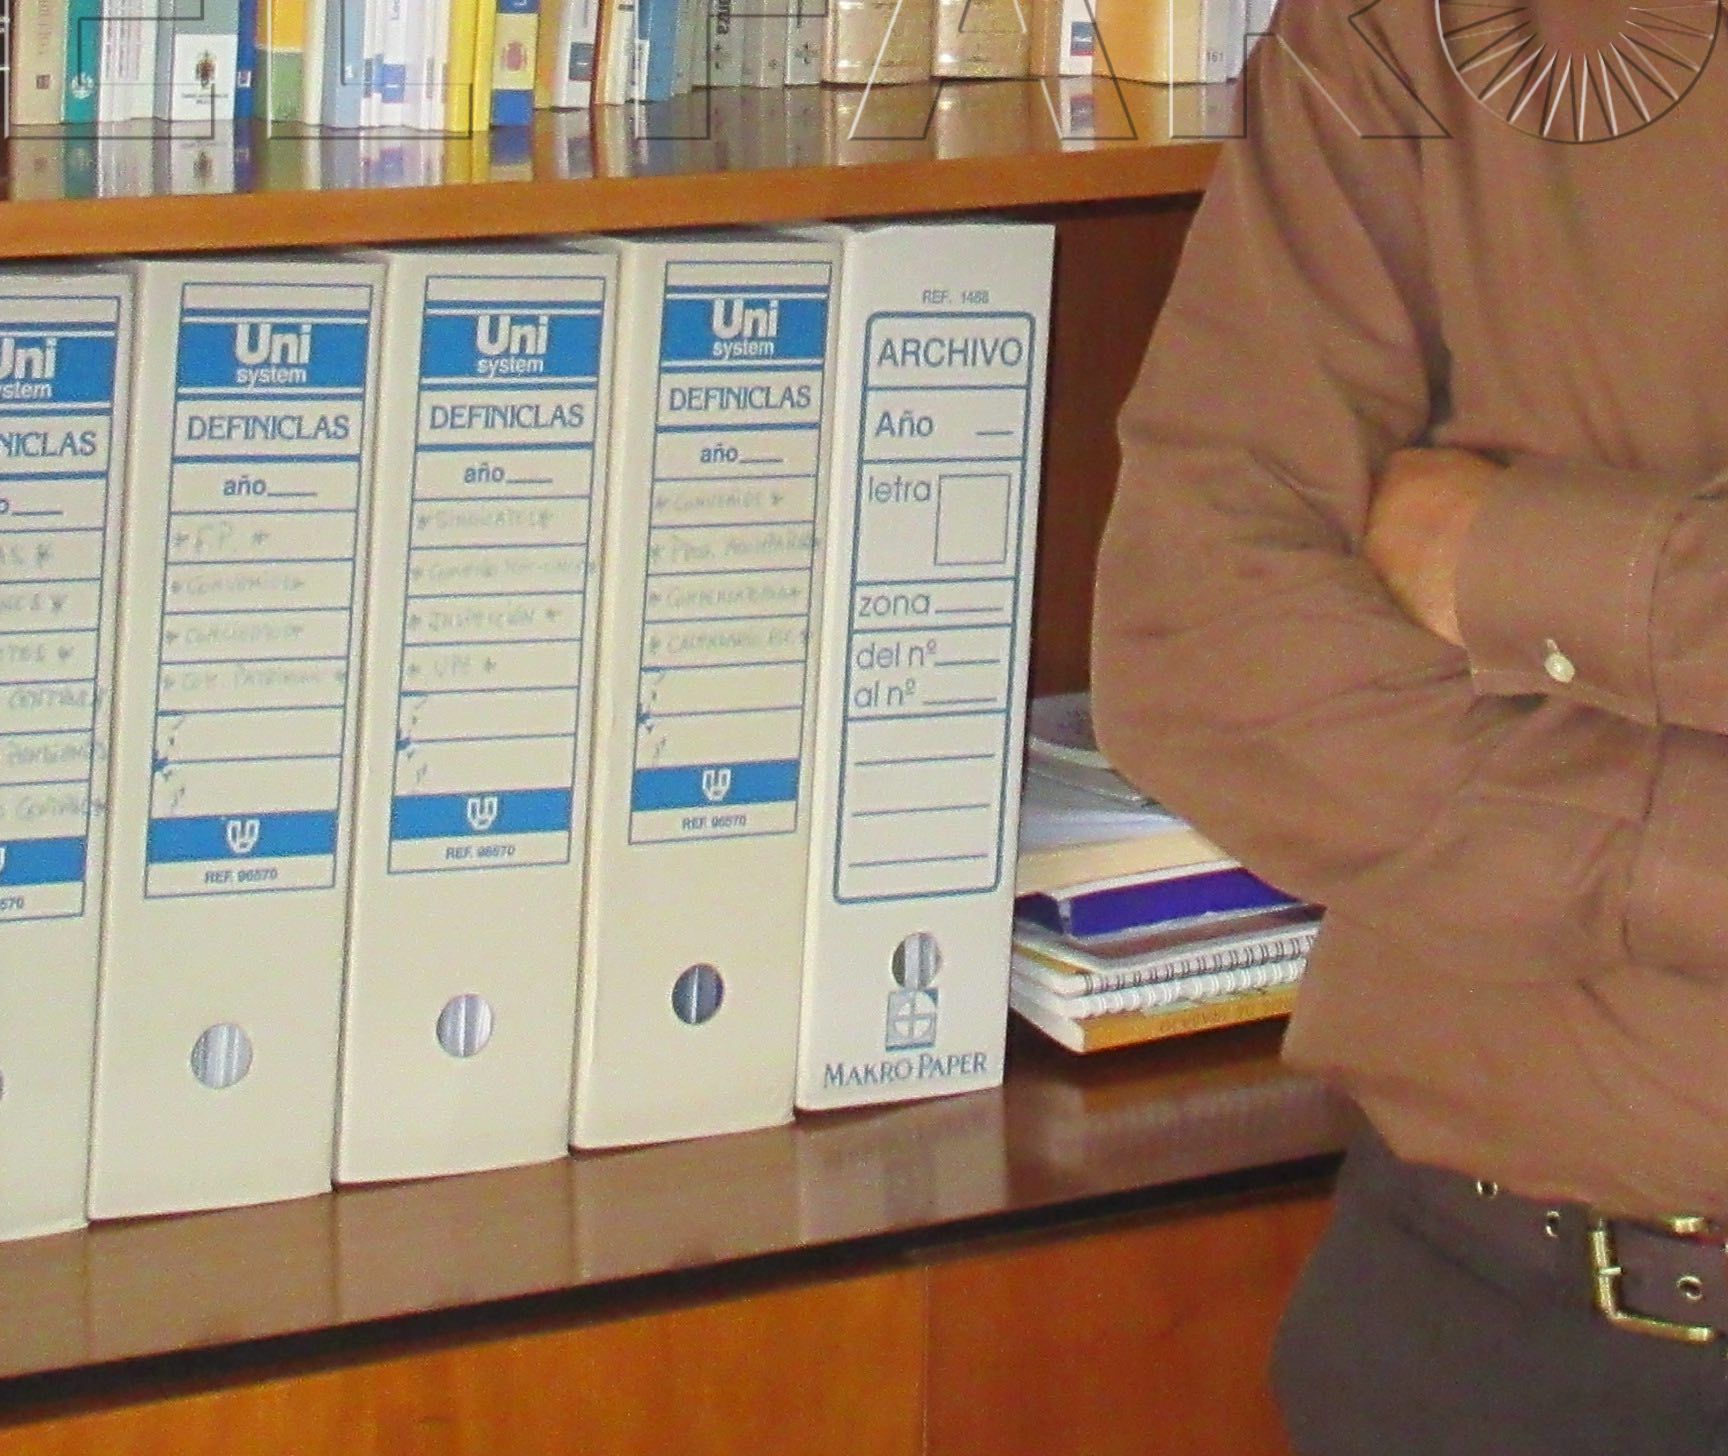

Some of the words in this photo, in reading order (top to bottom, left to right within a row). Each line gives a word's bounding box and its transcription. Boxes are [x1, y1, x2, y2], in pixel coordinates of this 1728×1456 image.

[921, 289, 953, 304] REF.
[712, 299, 779, 340] Uni
[235, 323, 312, 366] Uni
[477, 314, 548, 356] Uni
[712, 337, 775, 359] system
[477, 354, 544, 377] system
[877, 336, 1024, 370] ARCHIVO
[236, 365, 308, 386] system
[669, 384, 812, 413] DEFINICLAS
[187, 415, 351, 442] DEFINICLAS
[429, 402, 585, 432] DEFINICLAS
[875, 409, 935, 439] Año
[869, 475, 932, 505] letra
[858, 591, 932, 618] zona
[856, 642, 902, 670] del
[906, 642, 938, 668] nº
[855, 681, 881, 709] al
[888, 679, 918, 708] nº
